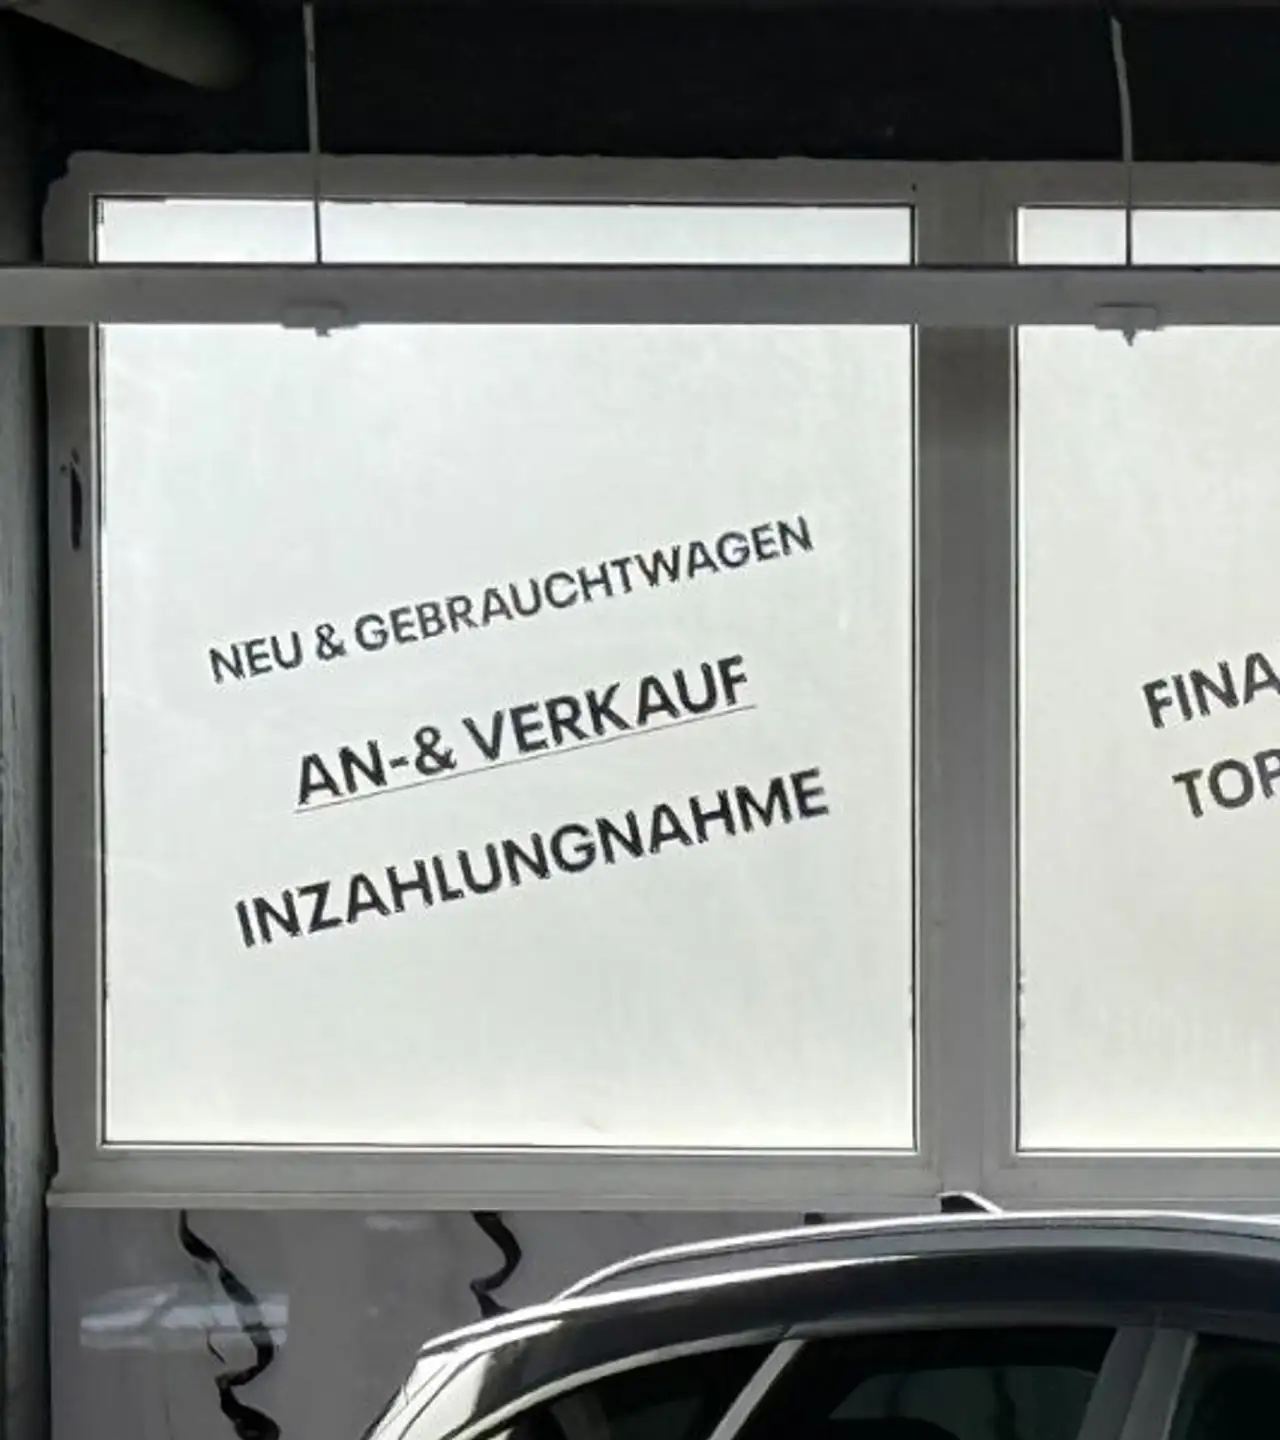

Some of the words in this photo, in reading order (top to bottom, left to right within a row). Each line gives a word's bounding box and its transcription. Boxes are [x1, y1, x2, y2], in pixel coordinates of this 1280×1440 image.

[208, 630, 304, 684] NEU
[314, 622, 348, 662] &
[353, 515, 814, 652] GEBRAUCHTWAGEN
[461, 654, 749, 762] VERKAUF
[235, 767, 830, 949] INZAHLUNGNAHME
